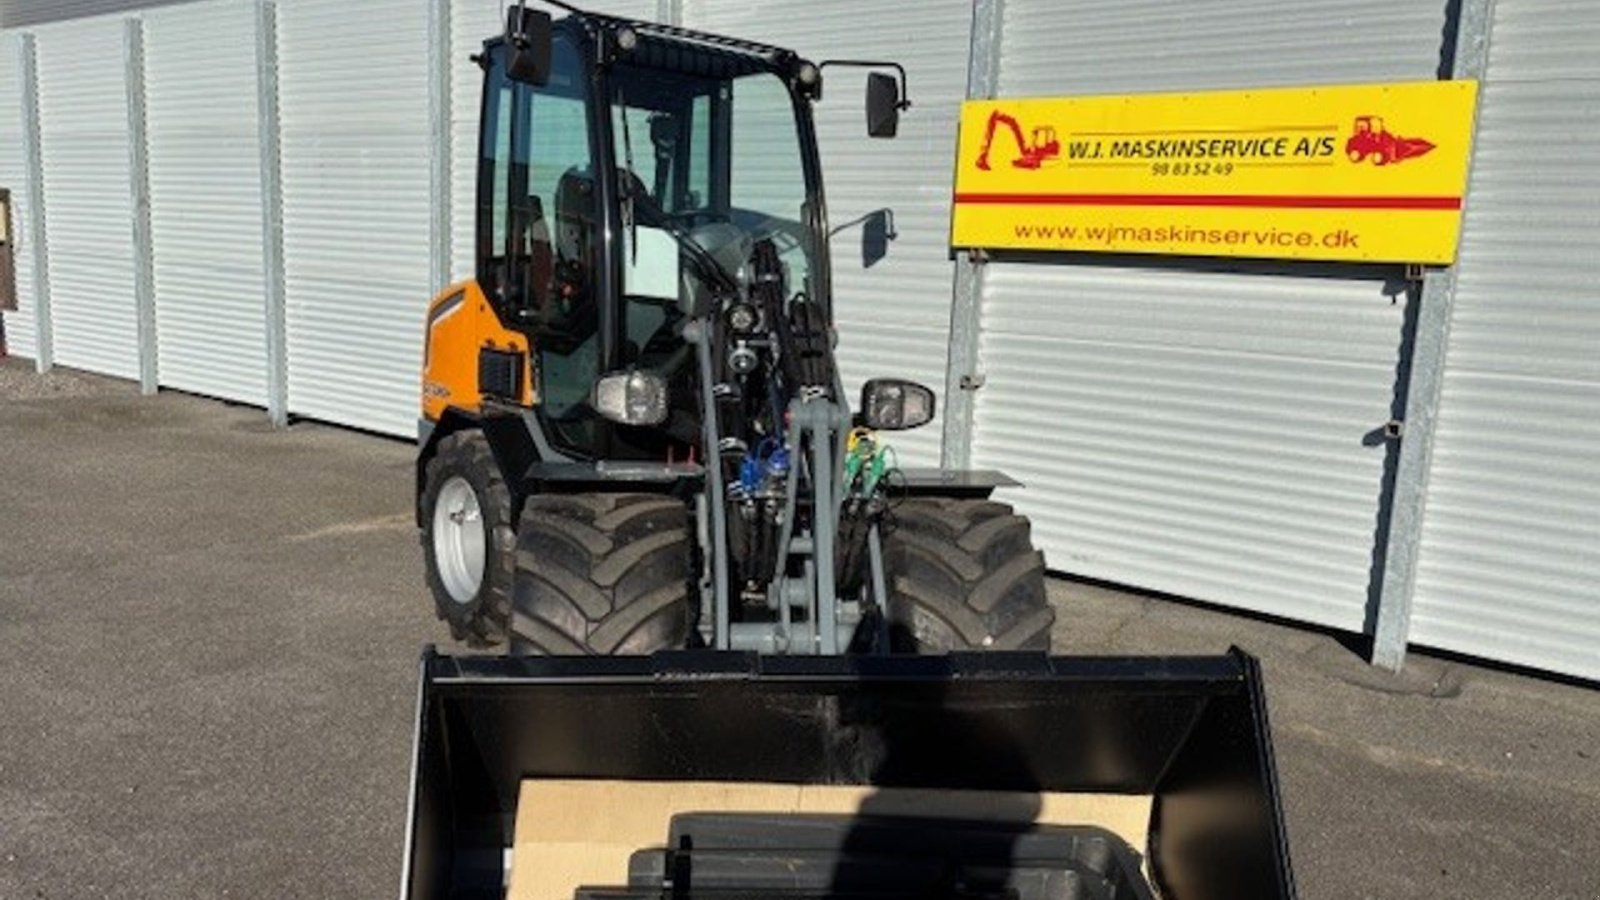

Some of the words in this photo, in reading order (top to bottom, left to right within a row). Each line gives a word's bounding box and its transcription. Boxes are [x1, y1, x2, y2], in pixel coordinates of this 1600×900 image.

[1110, 138, 1288, 158] MASKINSERVICE
[1292, 136, 1336, 158] A/S
[1014, 223, 1360, 249] www.wjmaskinservice.dk
